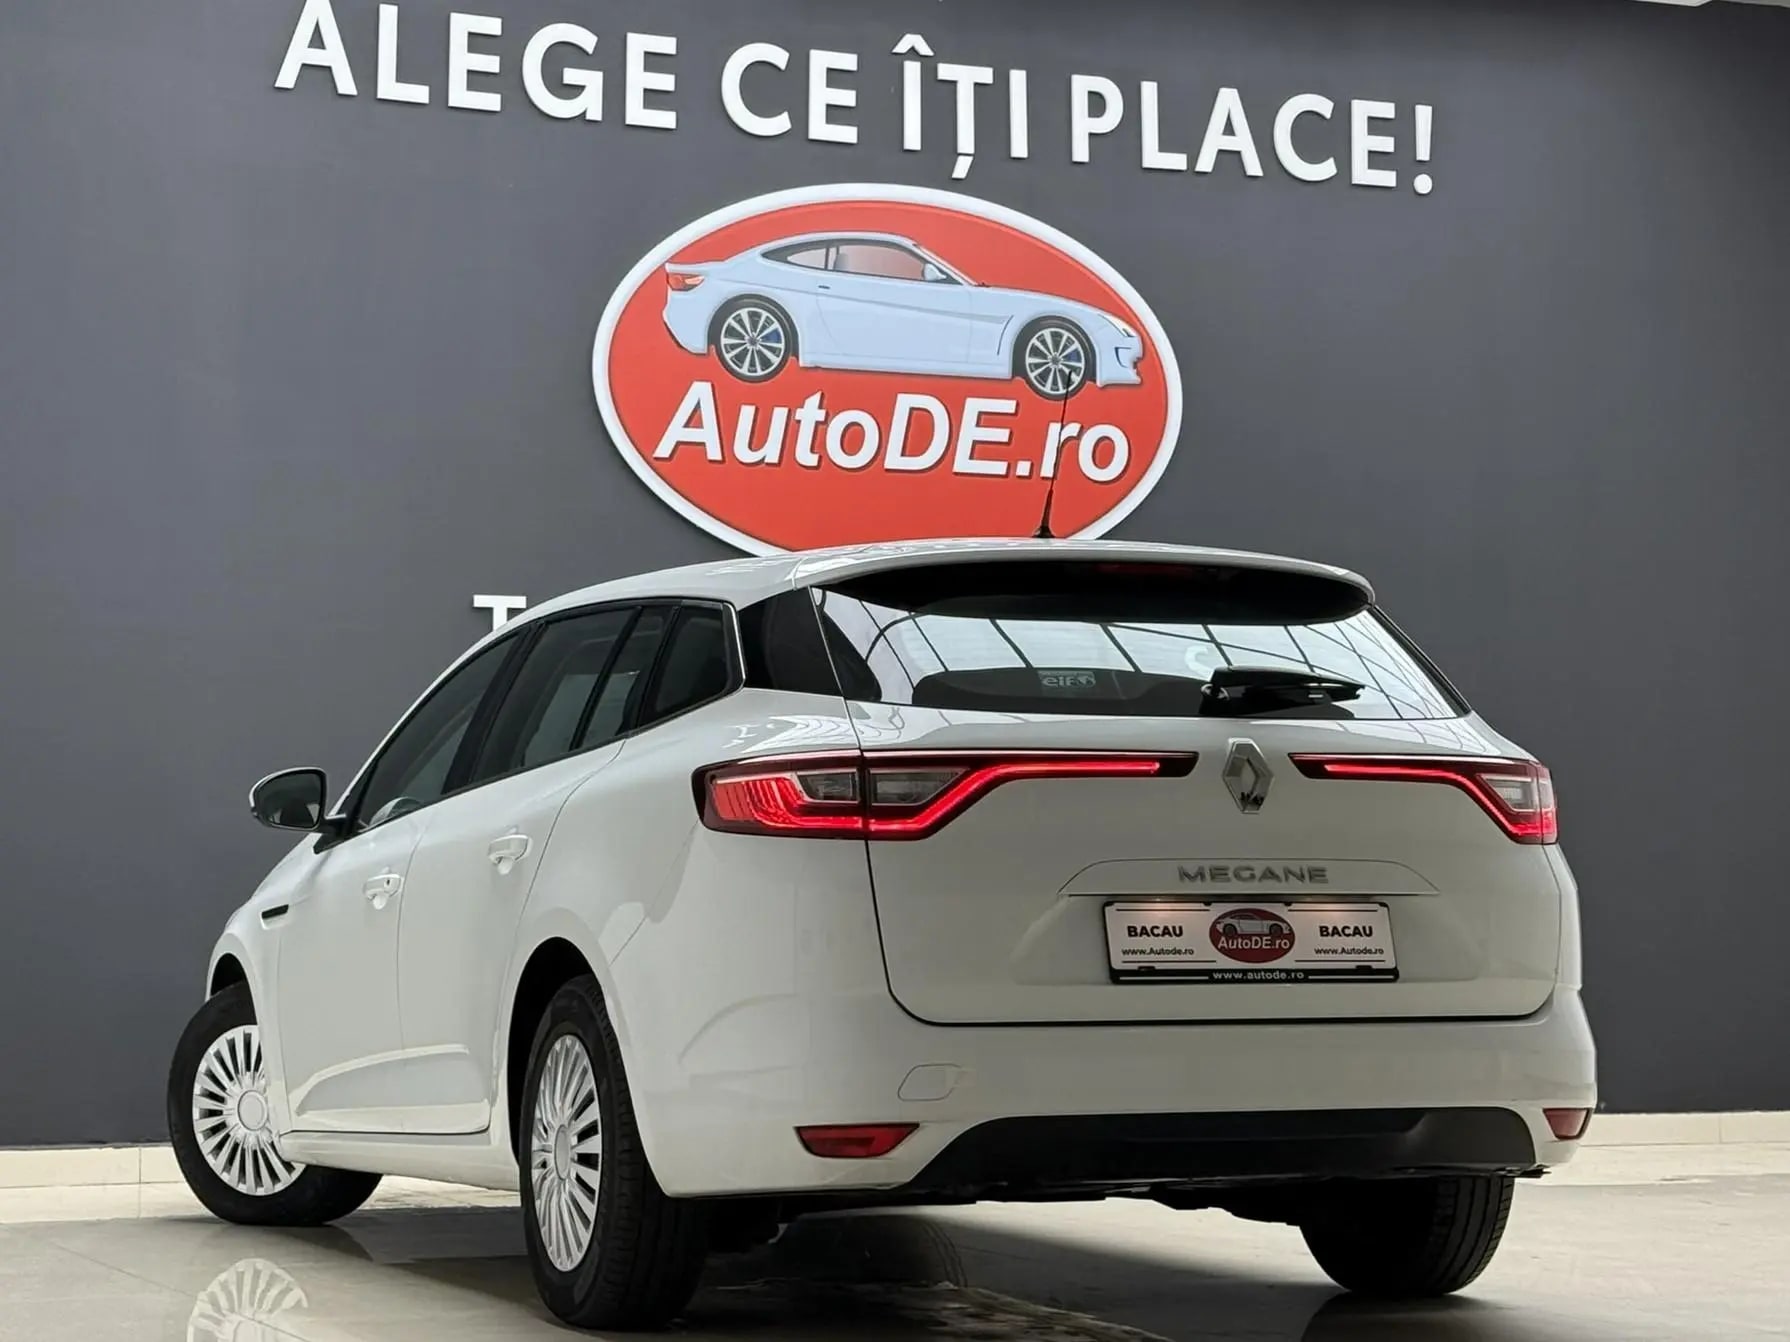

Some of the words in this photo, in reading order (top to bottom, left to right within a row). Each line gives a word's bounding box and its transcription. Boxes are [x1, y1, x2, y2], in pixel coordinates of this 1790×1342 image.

[274, 0, 678, 130] ALEGE
[721, 42, 858, 144] CE
[1071, 73, 1433, 195] PLACE!
[653, 381, 1131, 484] AutoDE.ro
[1177, 865, 1330, 884] MEGANE
[1127, 925, 1184, 938] BACAU
[1319, 925, 1374, 938] BACAU
[1217, 936, 1291, 950] AutoDE.ro
[1121, 946, 1195, 957] www.Autode.ro
[1314, 946, 1385, 956] www.Autode.ro
[1212, 970, 1305, 981] www.autode.ro
